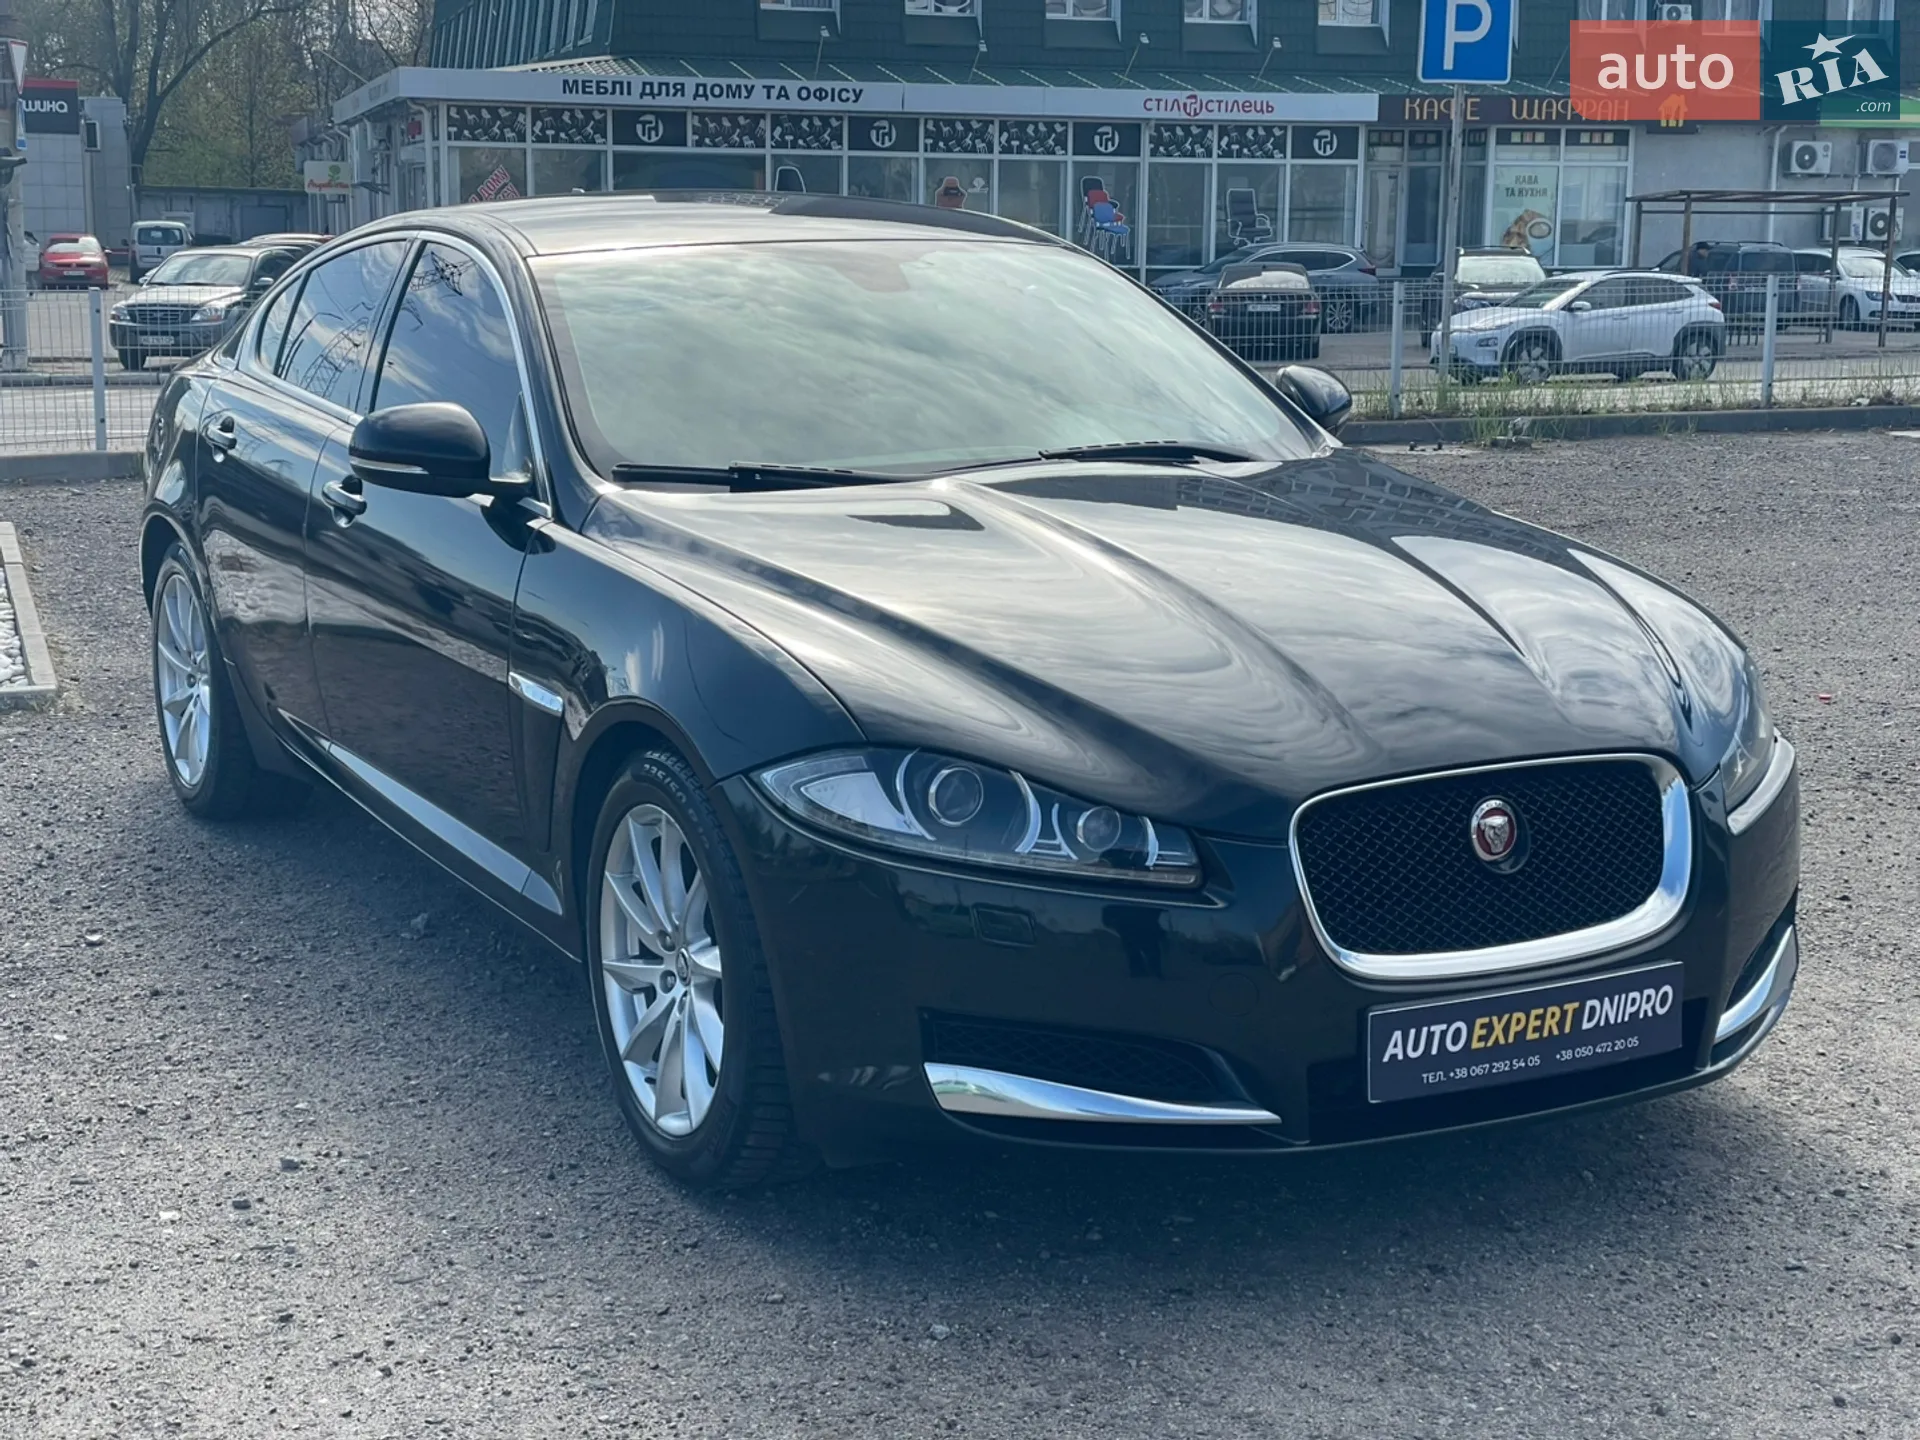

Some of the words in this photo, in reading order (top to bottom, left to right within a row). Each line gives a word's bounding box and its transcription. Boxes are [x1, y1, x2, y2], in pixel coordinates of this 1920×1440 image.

[1443, 0, 1493, 70] P
[562, 79, 632, 96] МЕБЛІ
[639, 81, 685, 99] ДЛЯ
[693, 83, 755, 101] ДОМУ
[762, 85, 790, 100] ТА
[797, 86, 864, 103] ОФІСУ
[1382, 1020, 1468, 1062] AUTO
[1471, 1002, 1580, 1049] EXPERT
[1581, 984, 1673, 1030] DNIPRO
[1422, 1071, 1446, 1084] ТЕЛ.
[1449, 1067, 1467, 1080] +38
[1469, 1063, 1490, 1077] 067
[1492, 1060, 1510, 1073] 292
[1512, 1057, 1525, 1070] 54
[1527, 1055, 1541, 1067] 05
[1556, 1048, 1572, 1061] +38
[1574, 1045, 1594, 1058] 050
[1595, 1041, 1612, 1054] 472
[1614, 1038, 1626, 1051] 20
[1627, 1036, 1639, 1048] 05
